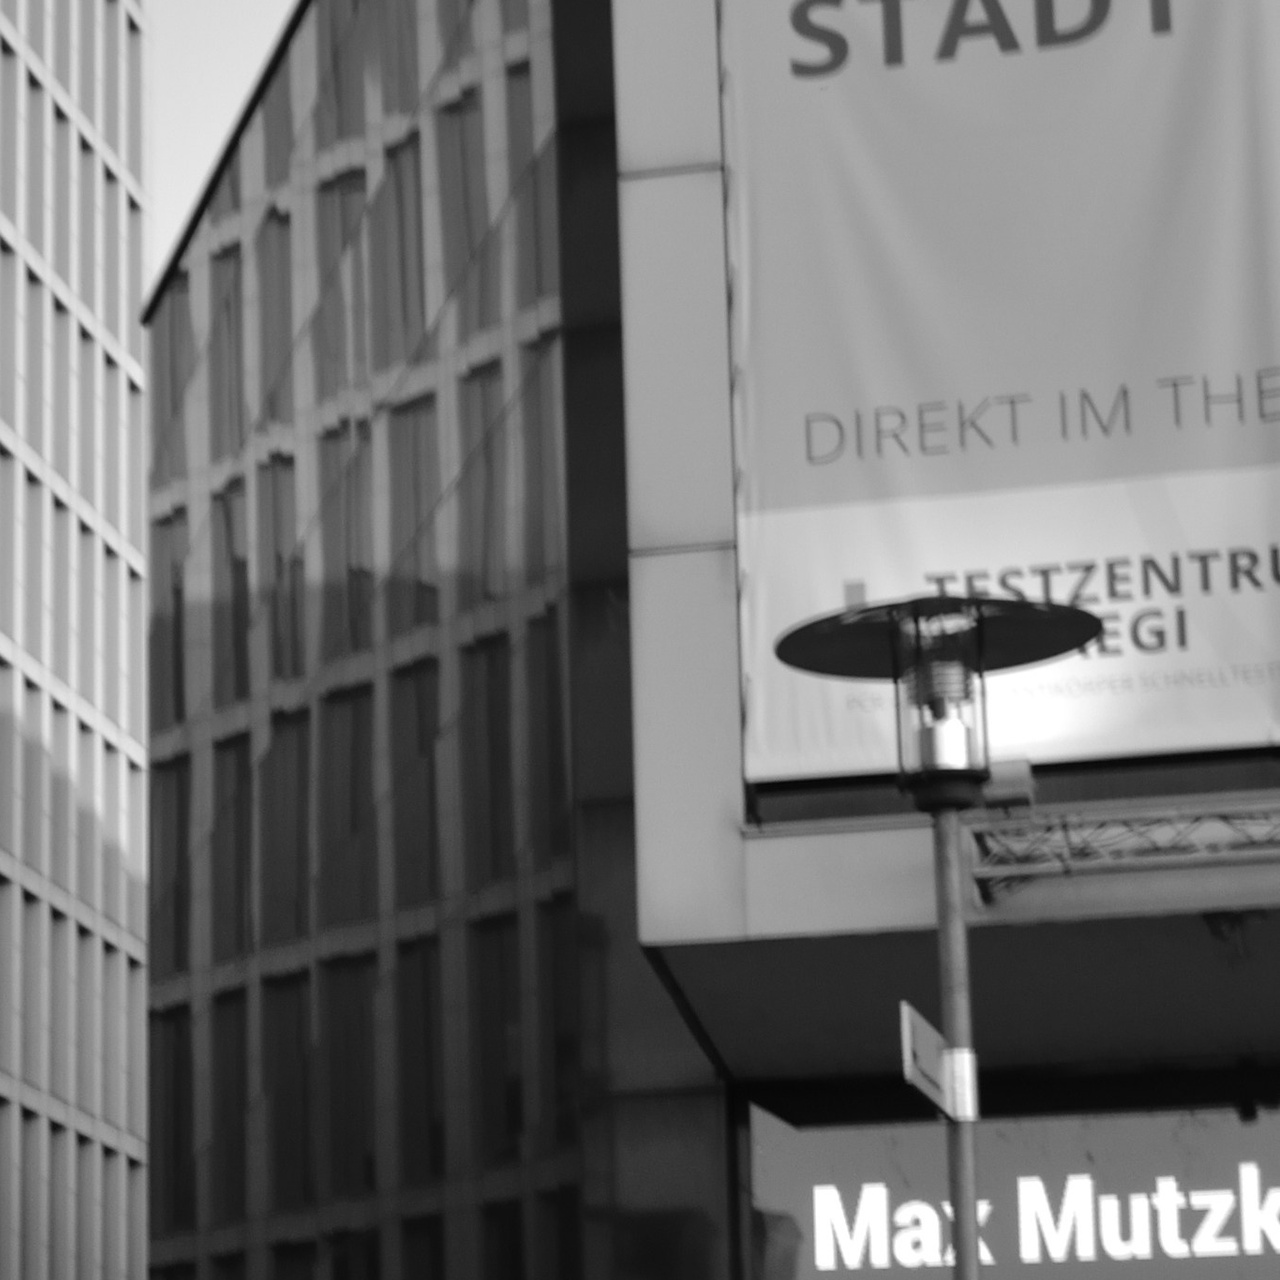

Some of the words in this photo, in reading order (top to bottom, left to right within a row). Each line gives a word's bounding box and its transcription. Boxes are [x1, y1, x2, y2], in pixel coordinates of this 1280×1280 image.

[803, 393, 1032, 466] DIREKT
[1058, 383, 1132, 441] IM
[924, 542, 1280, 610] TESTZENTR
[1017, 1162, 1280, 1263] Mutzk
